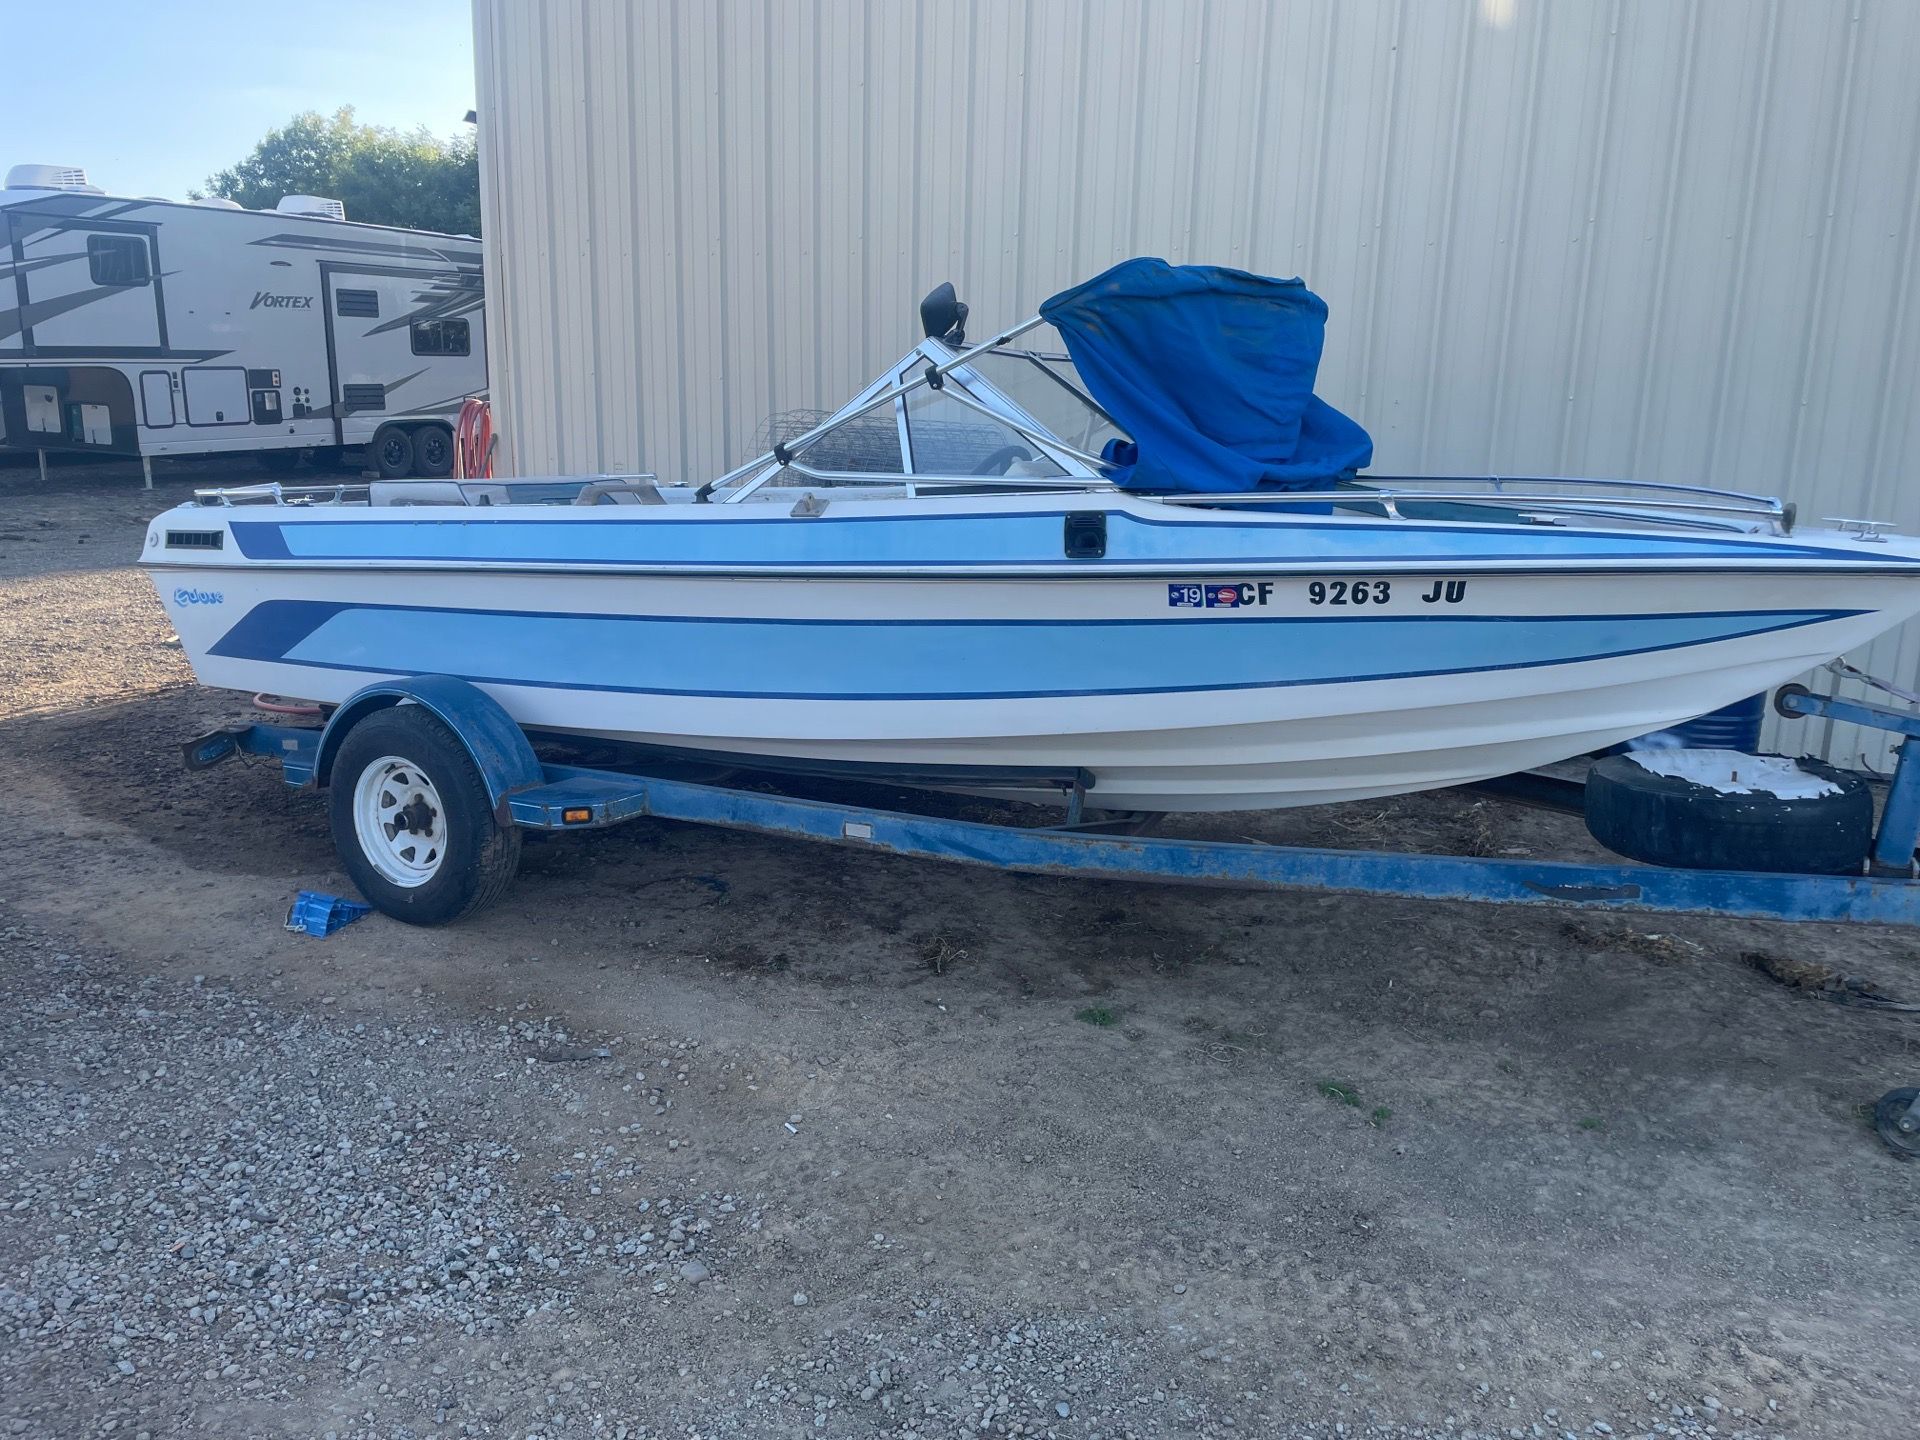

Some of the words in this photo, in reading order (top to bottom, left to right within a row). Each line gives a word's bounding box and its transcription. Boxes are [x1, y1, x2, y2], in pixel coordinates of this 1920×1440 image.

[249, 291, 314, 310] VORTEX
[1180, 588, 1201, 603] 19
[1238, 582, 1274, 606] CF
[1308, 581, 1391, 605] 9263
[1421, 580, 1467, 603] JU
